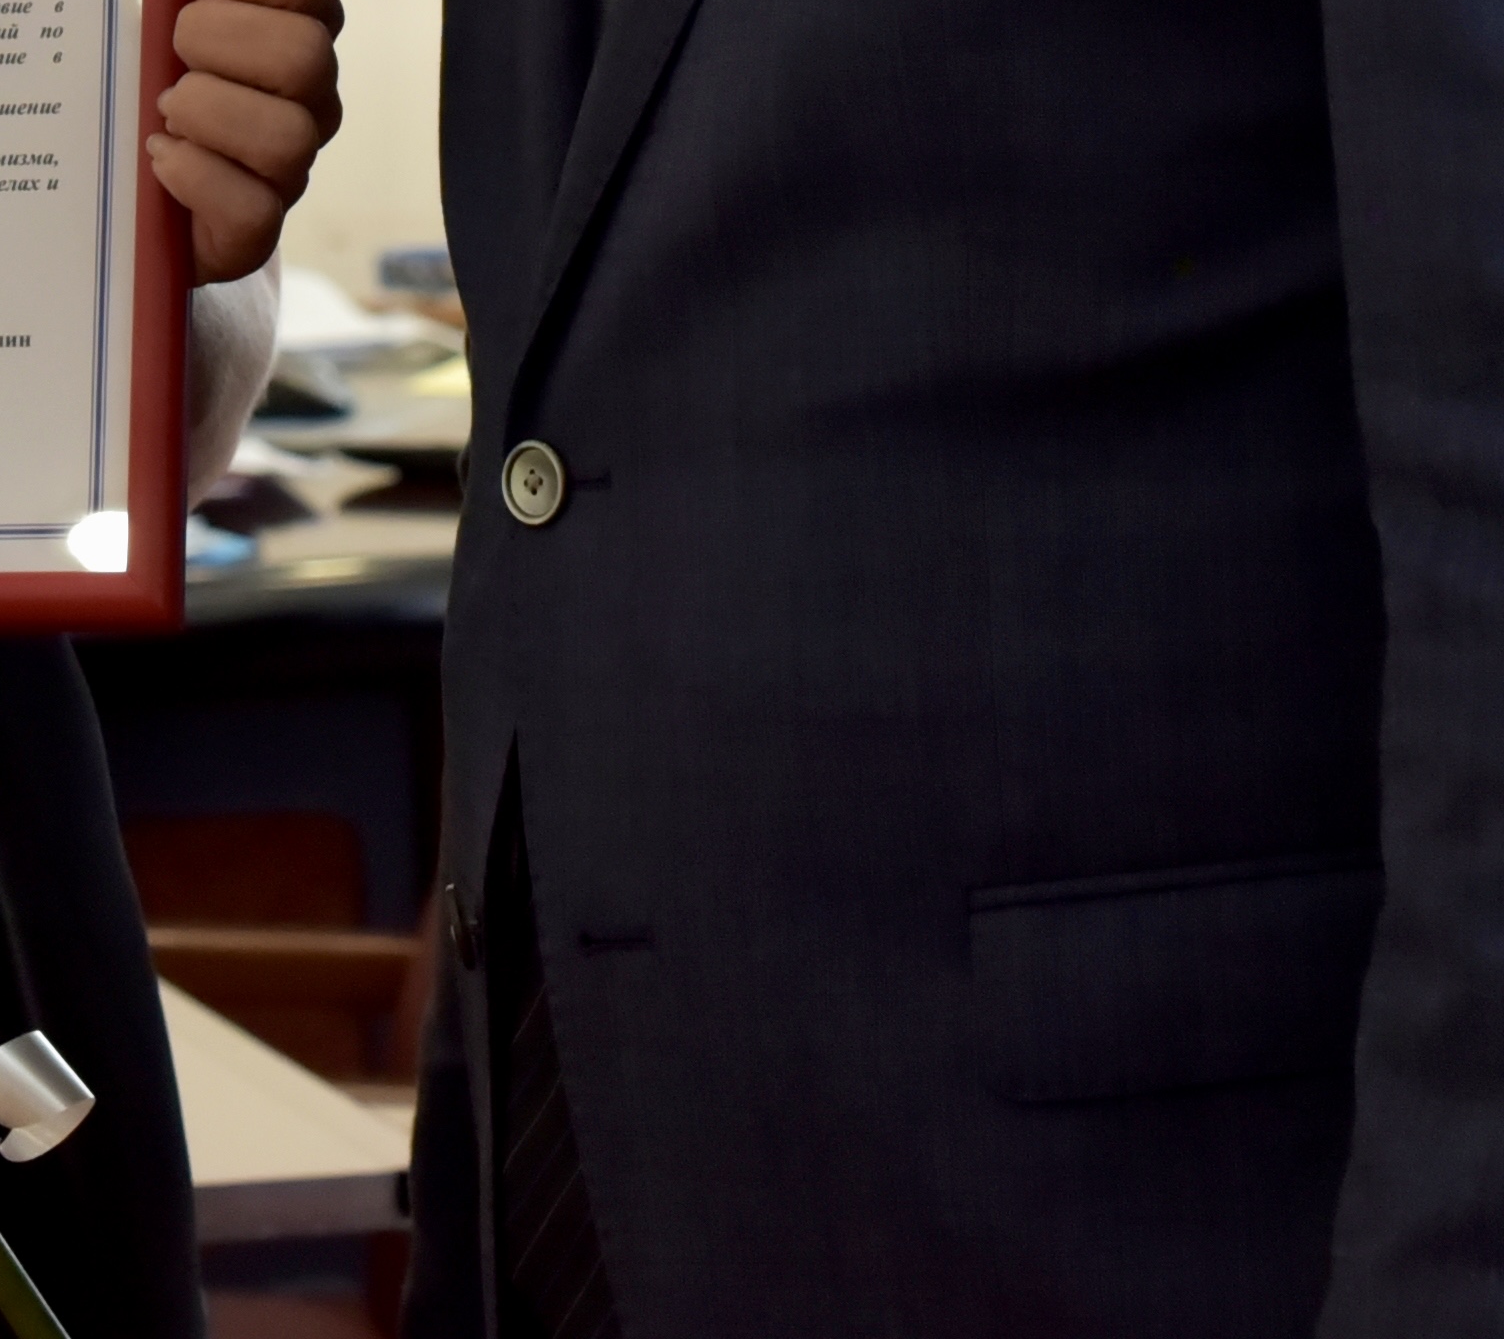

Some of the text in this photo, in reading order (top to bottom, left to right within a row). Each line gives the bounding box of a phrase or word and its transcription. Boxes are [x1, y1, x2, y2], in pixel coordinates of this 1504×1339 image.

[53, 0, 65, 14] в
[39, 26, 64, 39] по
[52, 51, 63, 64] в
[46, 178, 60, 191] и
